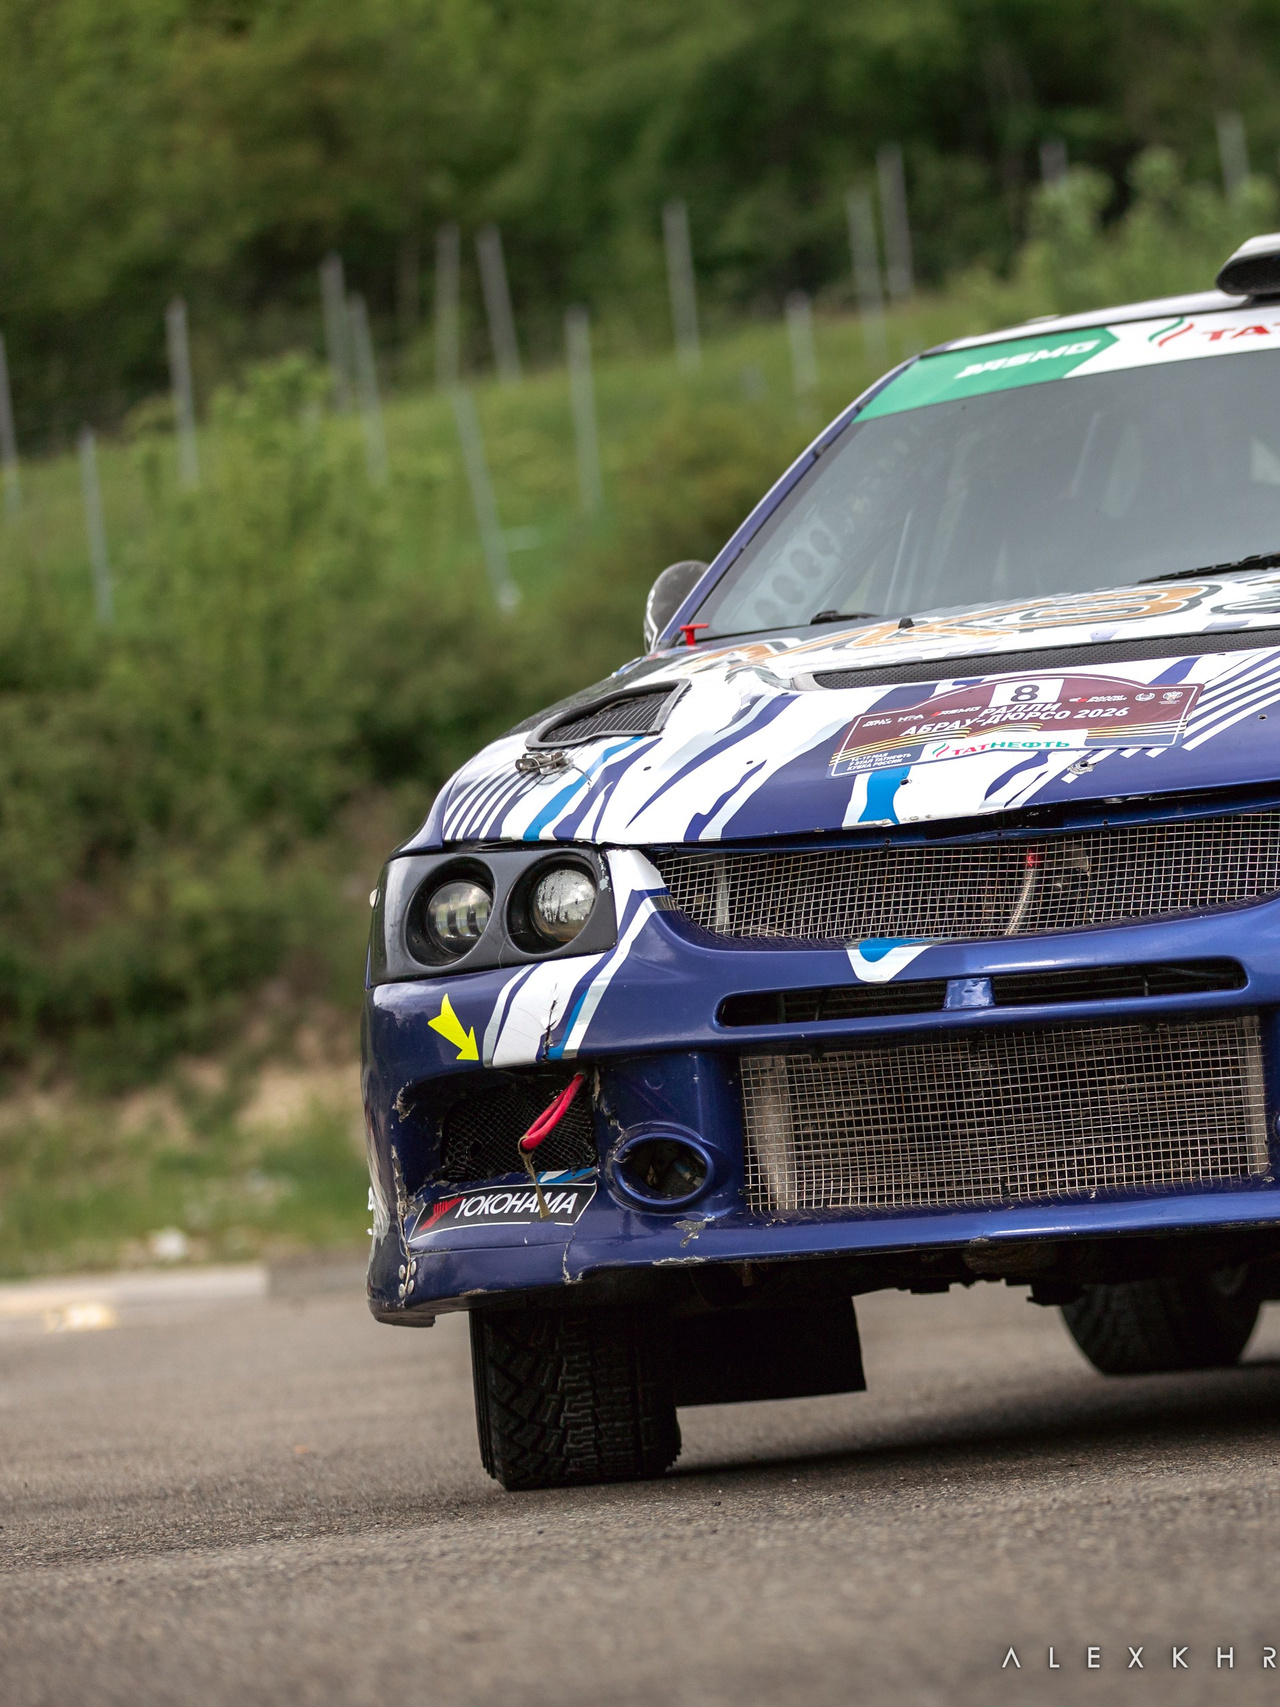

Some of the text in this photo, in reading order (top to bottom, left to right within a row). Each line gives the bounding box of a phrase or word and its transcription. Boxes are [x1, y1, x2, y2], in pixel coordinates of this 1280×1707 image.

[1009, 684, 1040, 703] 8
[978, 702, 1062, 718] РАЛЛИ
[899, 710, 1072, 737] АБРАУ-ДЮРСО
[1072, 707, 1131, 720] 2026
[952, 740, 1070, 756] ТАТНЕФТЬ
[454, 1192, 579, 1219] YOKOHAMA
